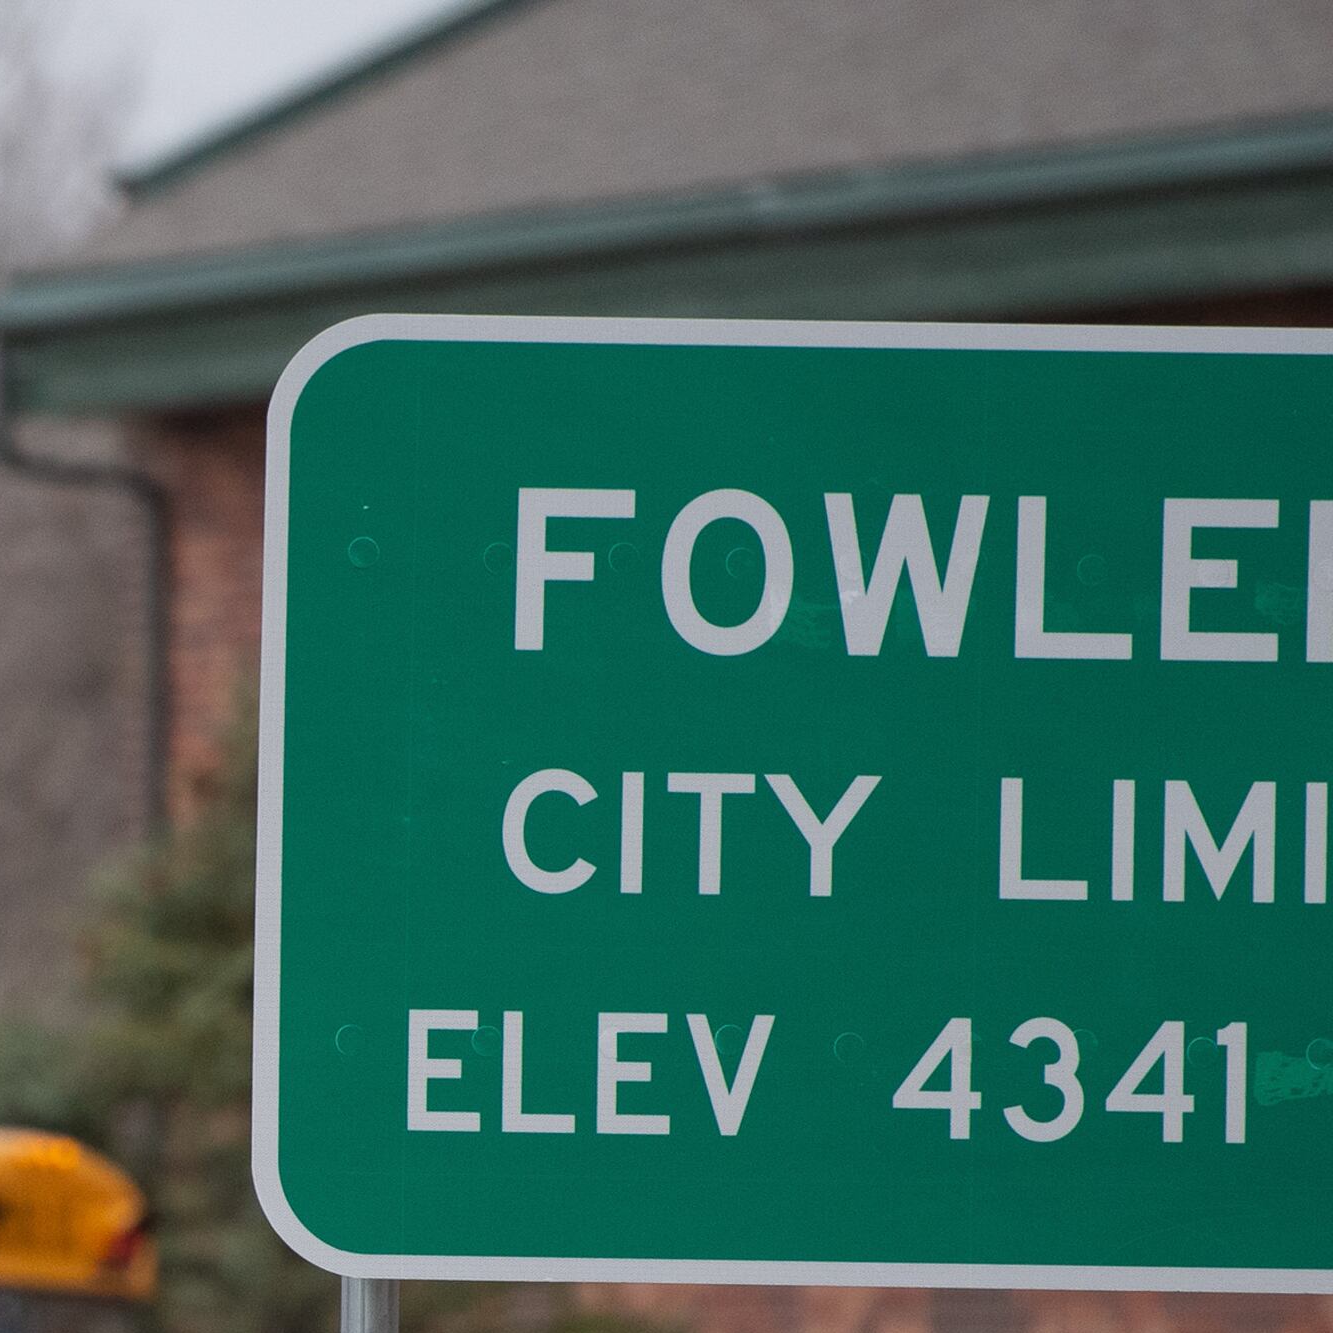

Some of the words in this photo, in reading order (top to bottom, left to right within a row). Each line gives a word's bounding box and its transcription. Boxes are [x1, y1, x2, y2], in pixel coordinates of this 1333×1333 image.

[514, 487, 1333, 662] FOWLE
[502, 768, 880, 897] CITY
[998, 778, 1329, 904] LIMI
[407, 1009, 775, 1136] ELEV
[892, 1016, 1247, 1143] 4341
